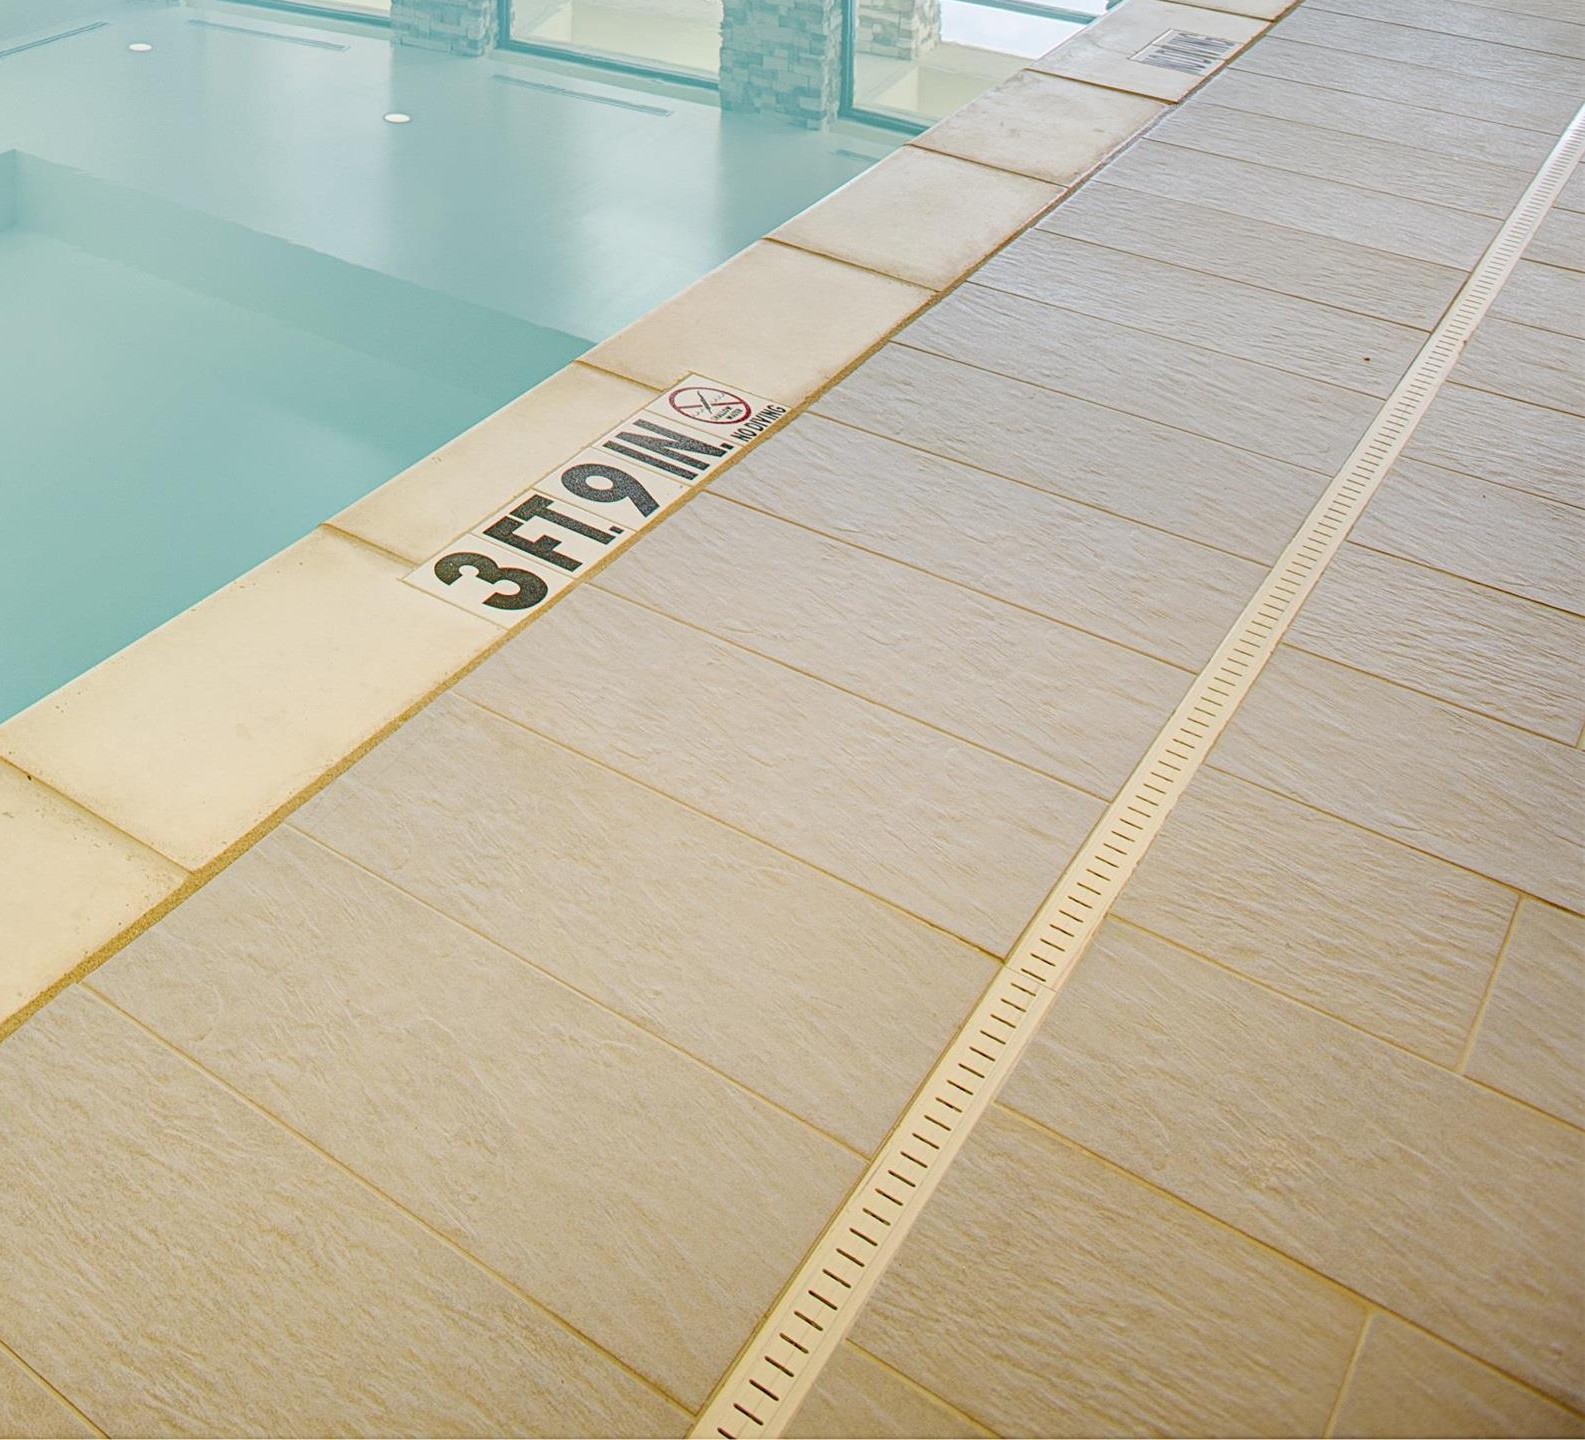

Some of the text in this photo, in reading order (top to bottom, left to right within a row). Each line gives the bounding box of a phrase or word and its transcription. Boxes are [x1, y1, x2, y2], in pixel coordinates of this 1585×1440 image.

[730, 405, 786, 442] NO DIVING
[433, 418, 734, 611] 3 FT. 9 IN.
